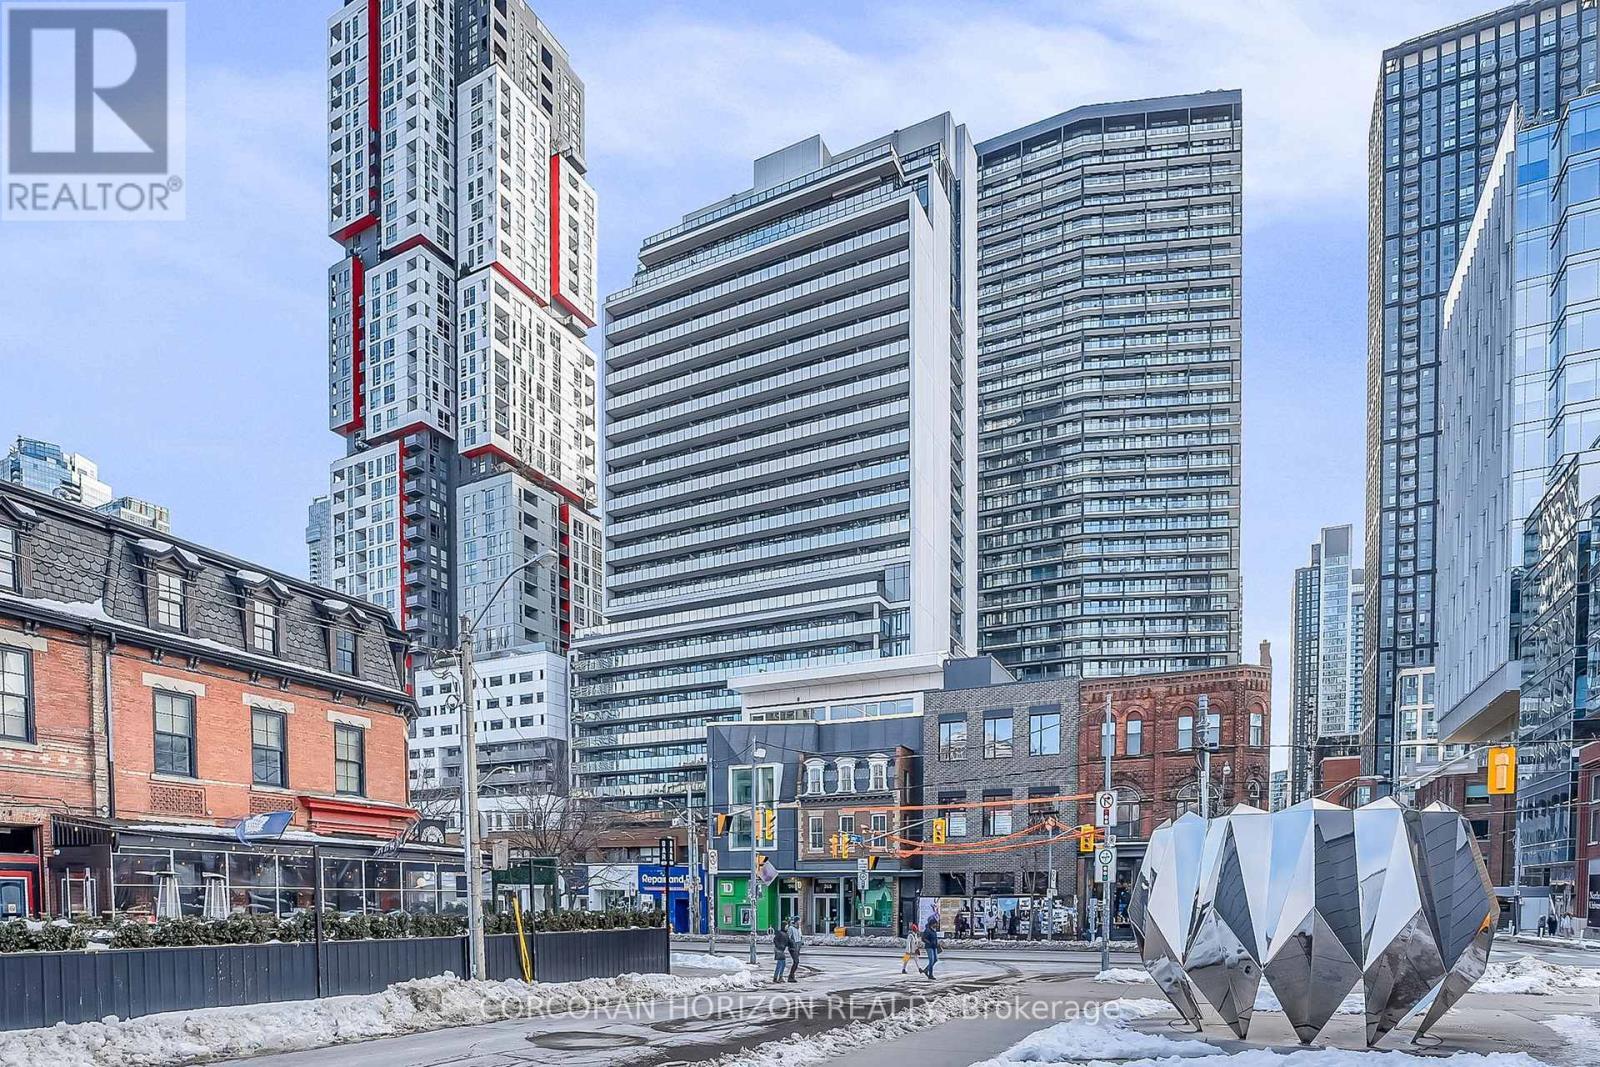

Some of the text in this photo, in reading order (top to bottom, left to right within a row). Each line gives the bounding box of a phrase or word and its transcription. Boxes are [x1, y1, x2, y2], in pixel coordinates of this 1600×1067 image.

[641, 874, 667, 885] Repai
[669, 874, 684, 883] and
[721, 882, 733, 893] TD
